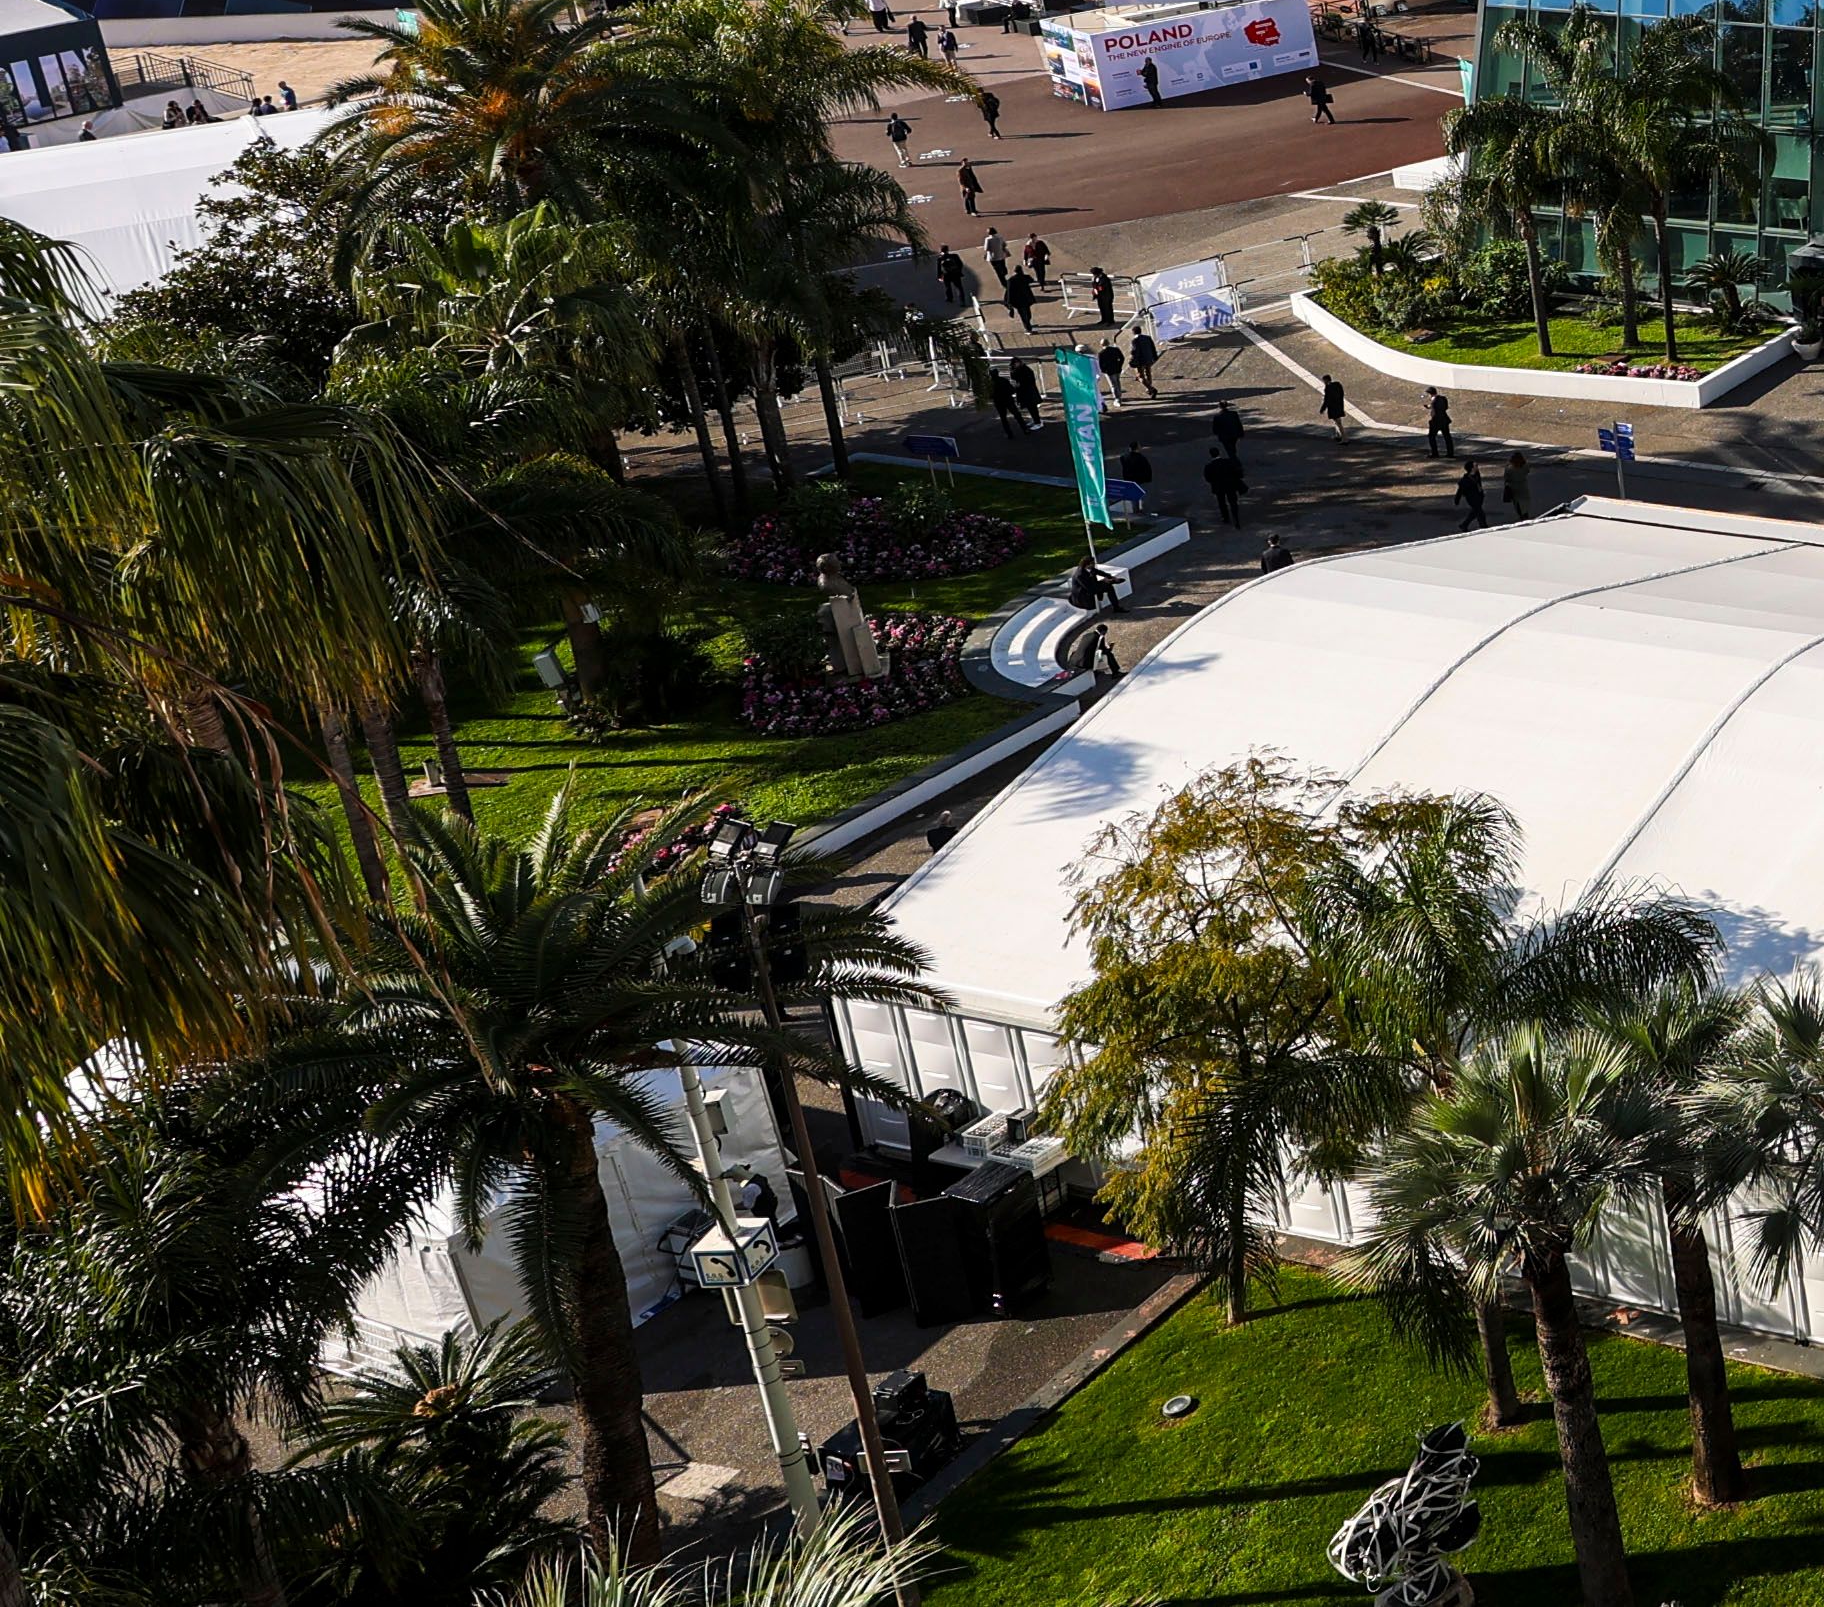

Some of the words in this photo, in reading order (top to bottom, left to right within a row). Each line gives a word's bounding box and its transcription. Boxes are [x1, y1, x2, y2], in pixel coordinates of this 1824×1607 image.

[1104, 24, 1193, 53] POLAND
[1107, 52, 1125, 62] THE
[1127, 48, 1147, 58] NEW
[1149, 42, 1182, 54] ENGINE
[1183, 39, 1195, 47] OF
[1197, 31, 1232, 45] EUROPE
[1190, 305, 1217, 321] Exit
